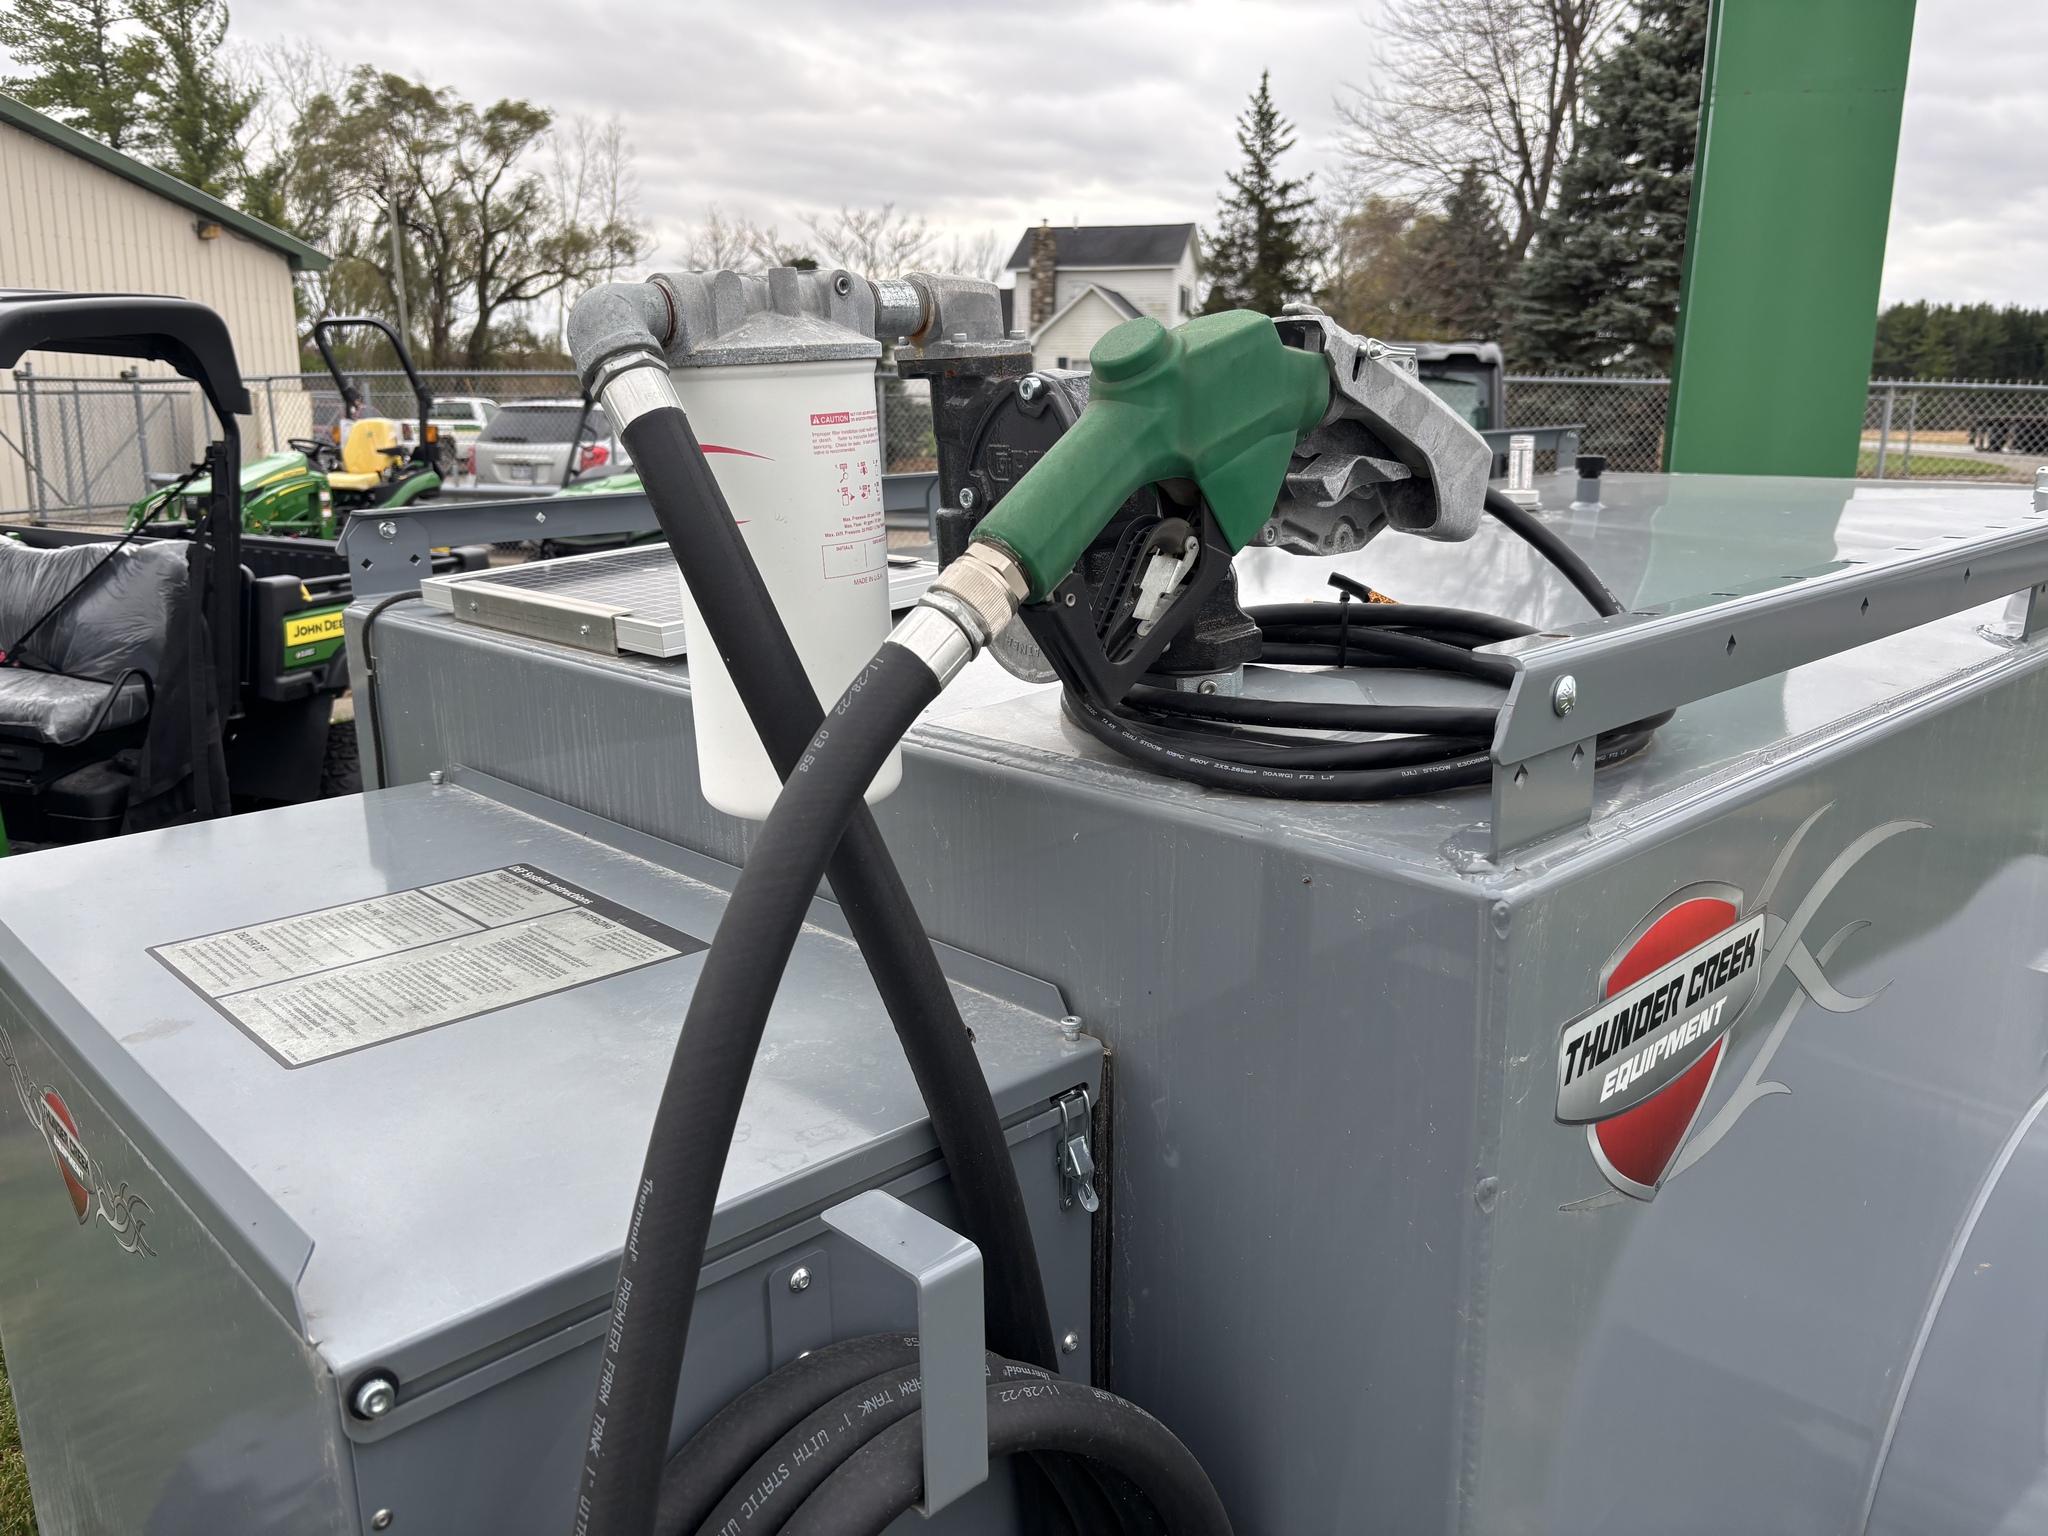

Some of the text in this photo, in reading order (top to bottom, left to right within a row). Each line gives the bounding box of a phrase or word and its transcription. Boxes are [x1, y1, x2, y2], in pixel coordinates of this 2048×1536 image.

[820, 415, 849, 424] CAUTION
[853, 576, 868, 586] MADE
[293, 619, 345, 638] JOHN DEE
[799, 657, 884, 773] 11/28/22 03:58
[1189, 756, 1210, 766] 600V
[1262, 770, 1294, 779] (10AWG)
[1401, 769, 1418, 778] (UL)
[1422, 764, 1452, 774] STOOW
[507, 864, 594, 905] DEF System Instructions
[1563, 927, 1761, 1087] THUNDER CREEK
[1599, 995, 1729, 1104] EQUIPMENT
[608, 1276, 633, 1353] PREMIER
[599, 1358, 616, 1406] FARM
[898, 1376, 922, 1397] ARM
[998, 1384, 1061, 1403] 11/28/22
[1091, 1388, 1114, 1402] USA
[856, 1389, 894, 1417] TANK
[589, 1413, 606, 1458] TANK
[792, 1429, 830, 1466] WITH
[740, 1463, 790, 1519] STATIC
